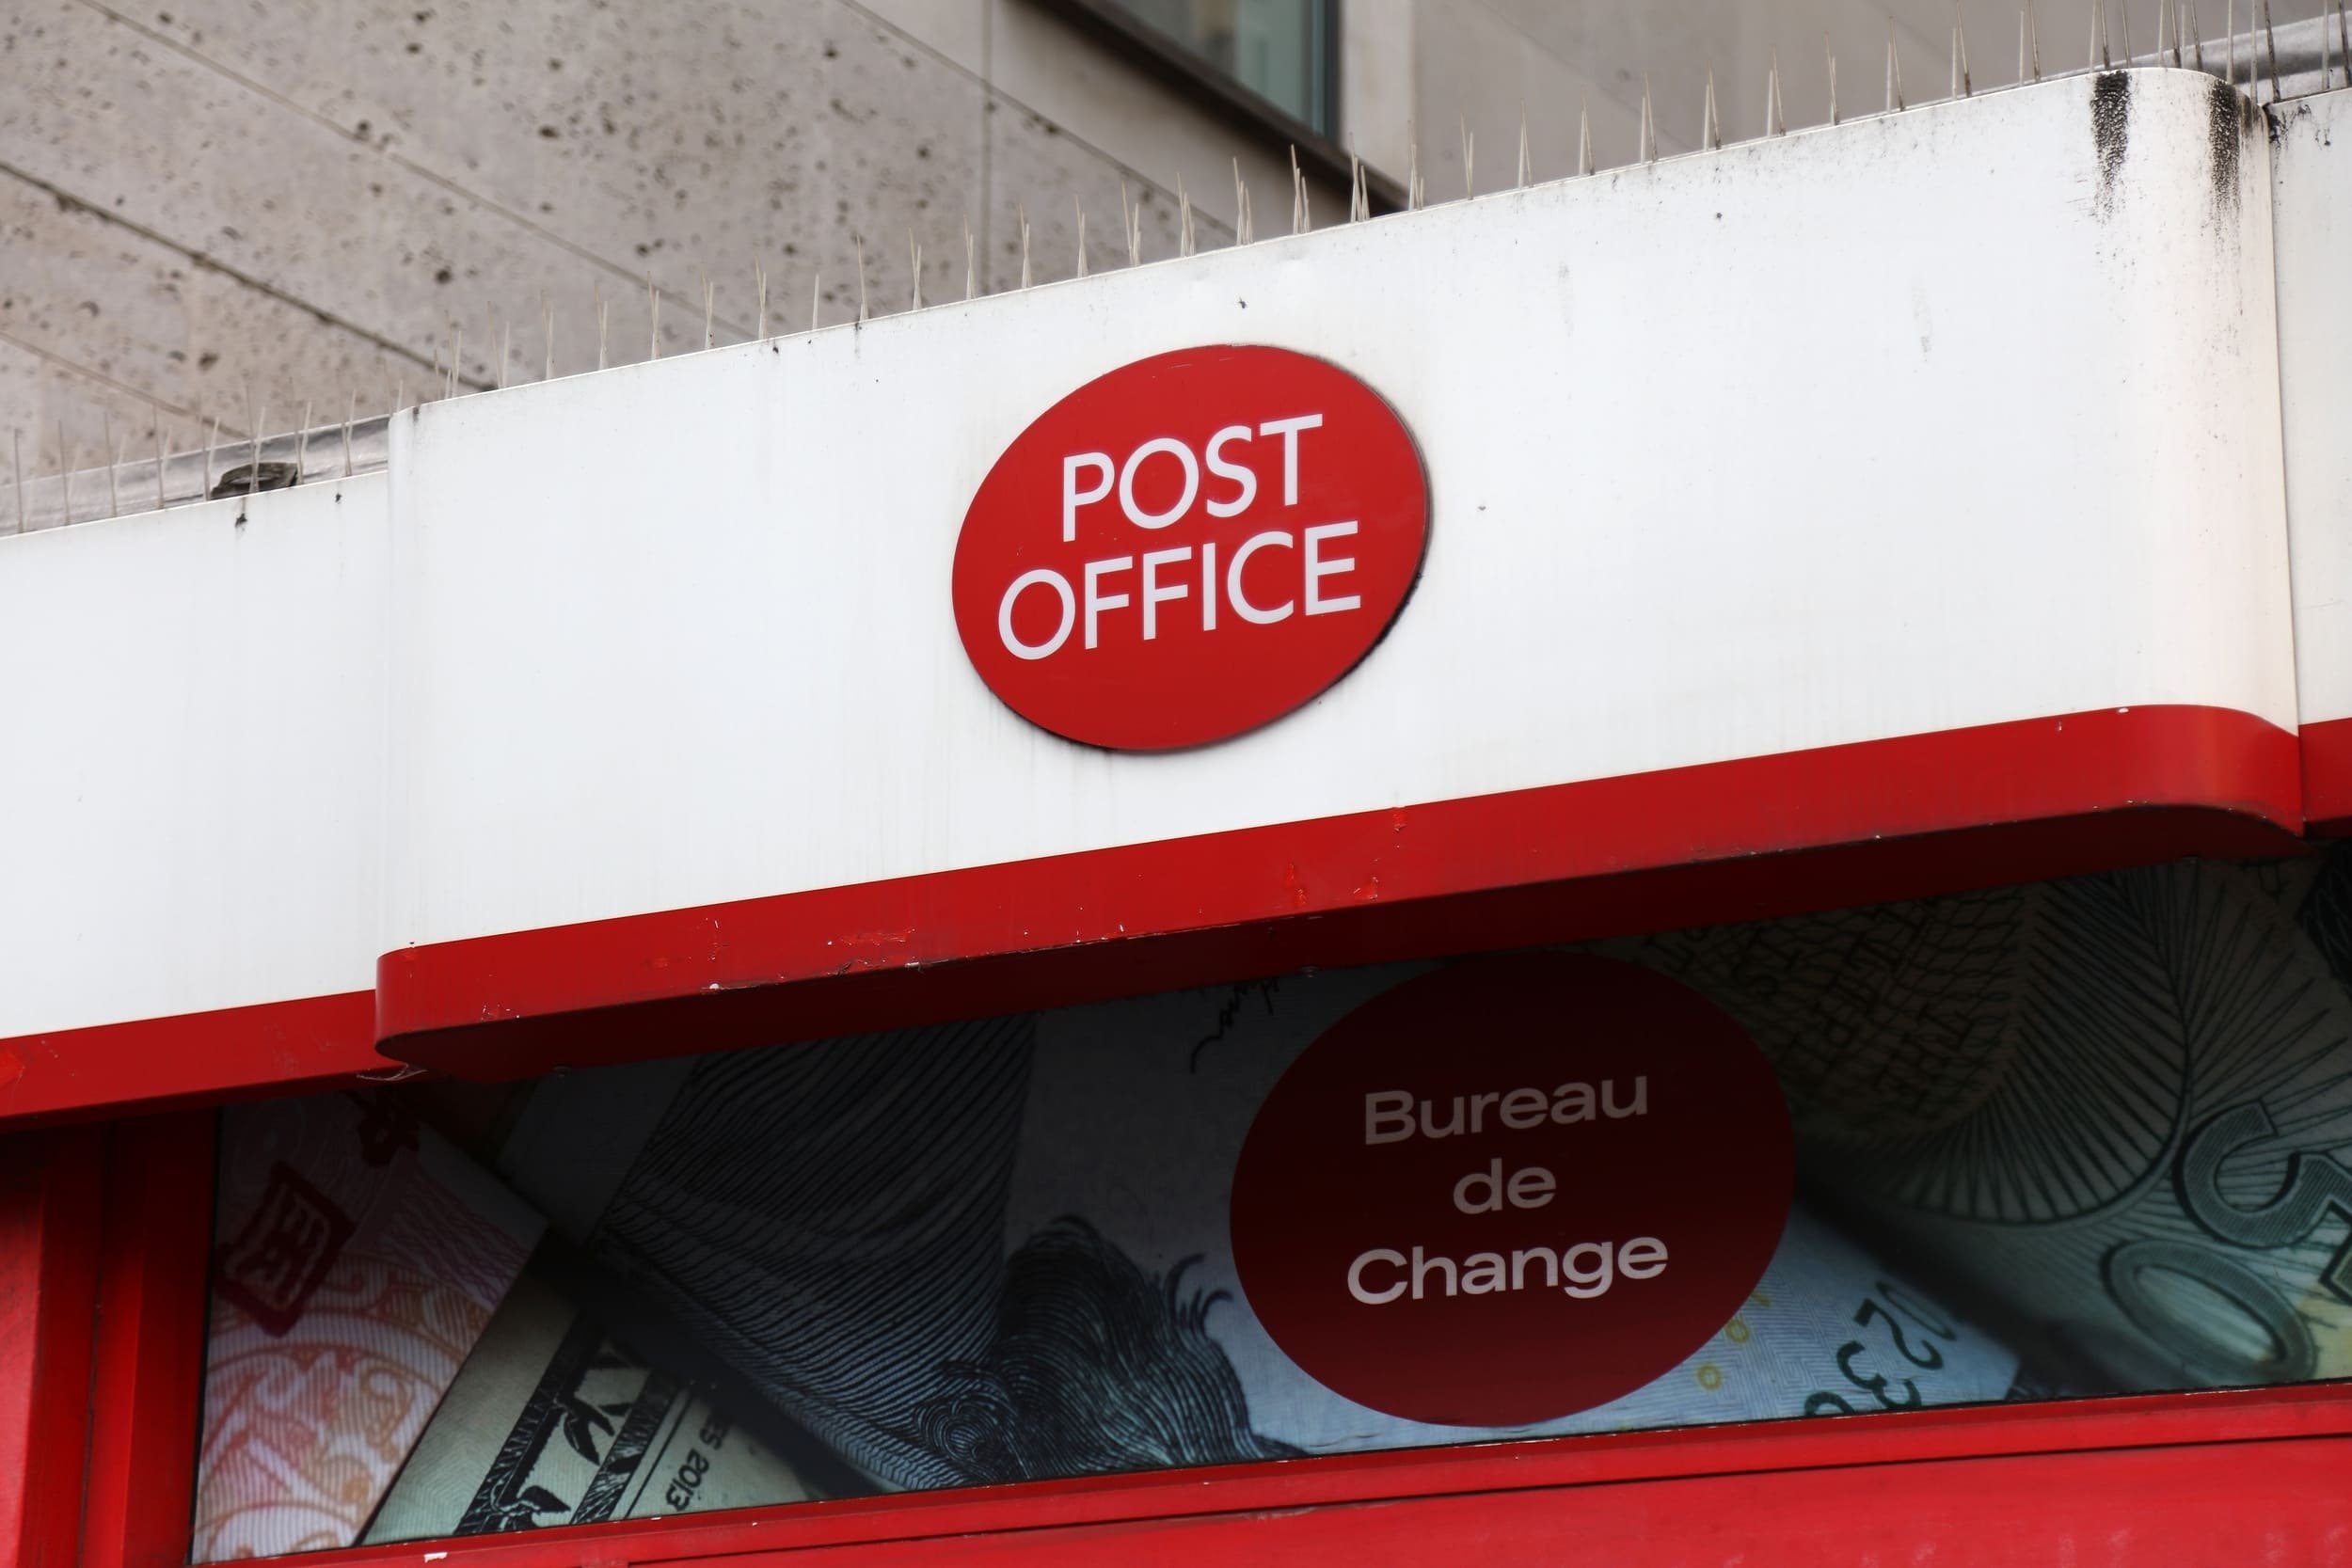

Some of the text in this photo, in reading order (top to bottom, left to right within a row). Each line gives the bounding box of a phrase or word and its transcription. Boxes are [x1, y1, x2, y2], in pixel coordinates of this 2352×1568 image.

[1062, 413, 1324, 543] POST
[997, 519, 1362, 661] OFFICE
[1364, 1074, 1649, 1146] Bureau
[1452, 1157, 1557, 1215] de
[1346, 1234, 1670, 1306] Change
[665, 1447, 710, 1512] 2013
